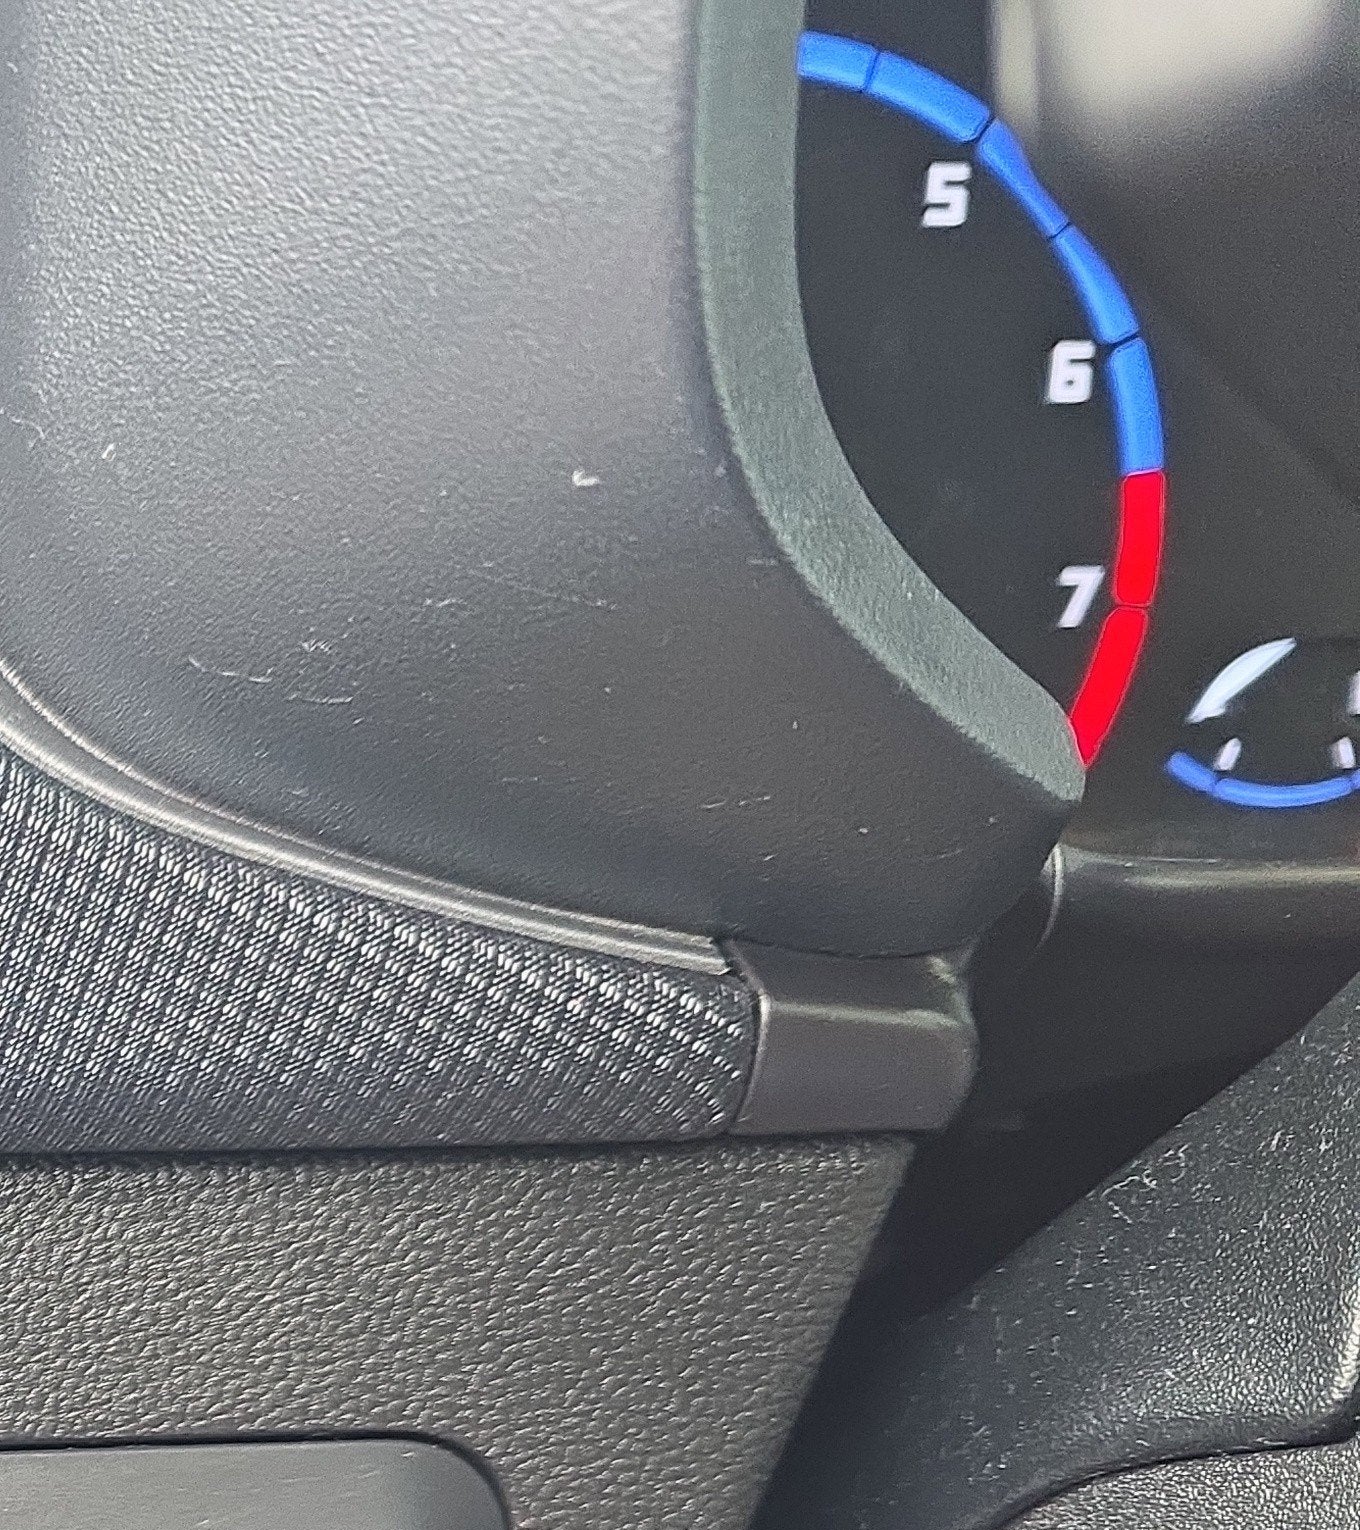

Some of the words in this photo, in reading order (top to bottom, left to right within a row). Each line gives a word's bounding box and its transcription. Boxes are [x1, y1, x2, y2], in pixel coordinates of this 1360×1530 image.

[921, 161, 972, 228] 5
[1044, 340, 1096, 404] 6
[1056, 565, 1106, 628] 7
